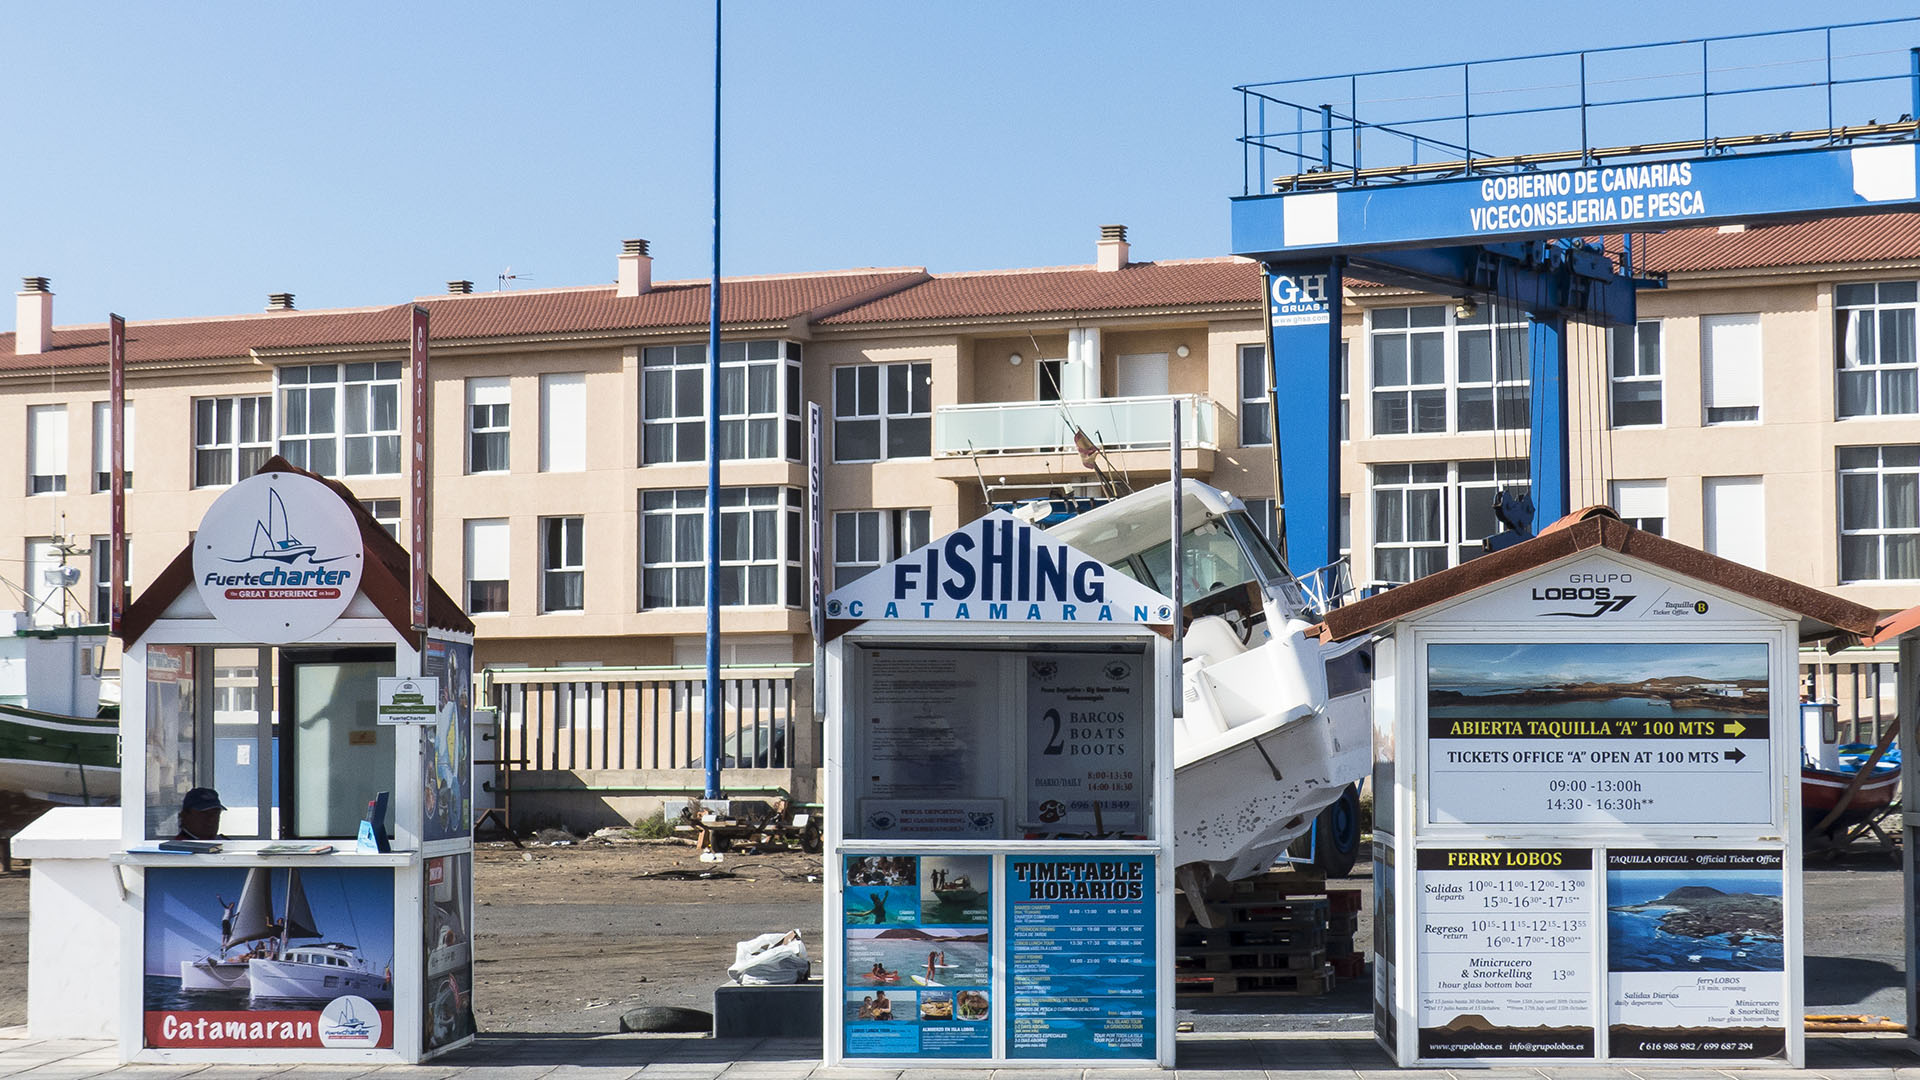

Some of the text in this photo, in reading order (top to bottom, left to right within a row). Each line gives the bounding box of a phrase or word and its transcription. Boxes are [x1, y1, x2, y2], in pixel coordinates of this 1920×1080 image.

[1482, 162, 1692, 201] GOBIERNO DE CANARIAS
[1470, 190, 1705, 230] VICECONSEJERIA DE PESCA
[1272, 274, 1328, 304] GH
[1282, 304, 1320, 312] GRUAS
[811, 409, 820, 605] FISHING
[894, 520, 1104, 603] FISHING
[1570, 574, 1632, 583] GRUPO
[1532, 588, 1610, 600] LOBOS
[850, 601, 1148, 621] CATAMARÁN
[1070, 712, 1124, 723] BARCOS
[1043, 708, 1064, 755] 2
[1070, 728, 1124, 739] BOATS
[1450, 721, 1522, 735] ABIERTA
[1527, 721, 1611, 738] TAQUILLA
[1643, 722, 1674, 735] 100
[1679, 721, 1714, 735] MTS
[1070, 744, 1124, 755] BOOTS
[1447, 751, 1508, 764] TICKETS
[1512, 751, 1563, 764] OFFICE
[1591, 751, 1630, 764] OPEN
[1633, 751, 1653, 763] AT
[1657, 751, 1683, 764] 100
[1688, 751, 1719, 764] MTS
[1549, 780, 1587, 792] 09:00
[1546, 799, 1583, 810] 14:30
[1448, 852, 1562, 866] FERRY LOBOS
[1609, 856, 1652, 864] TAQUILLA
[1696, 855, 1726, 864] Official
[1756, 855, 1780, 864] Office
[1014, 862, 1143, 882] TIMETABLE
[1030, 882, 1142, 900] HORARIOS
[1424, 884, 1463, 893] Salidas
[1436, 893, 1464, 902] departs
[1424, 924, 1464, 935] Regreso
[1469, 959, 1532, 967] Minicrucero
[1473, 969, 1532, 980] Snorkelling
[1463, 982, 1482, 990] glass
[163, 1014, 312, 1040] Catamaran
[1430, 1042, 1584, 1053] www.grupolobos.es info@grupolobos.es
